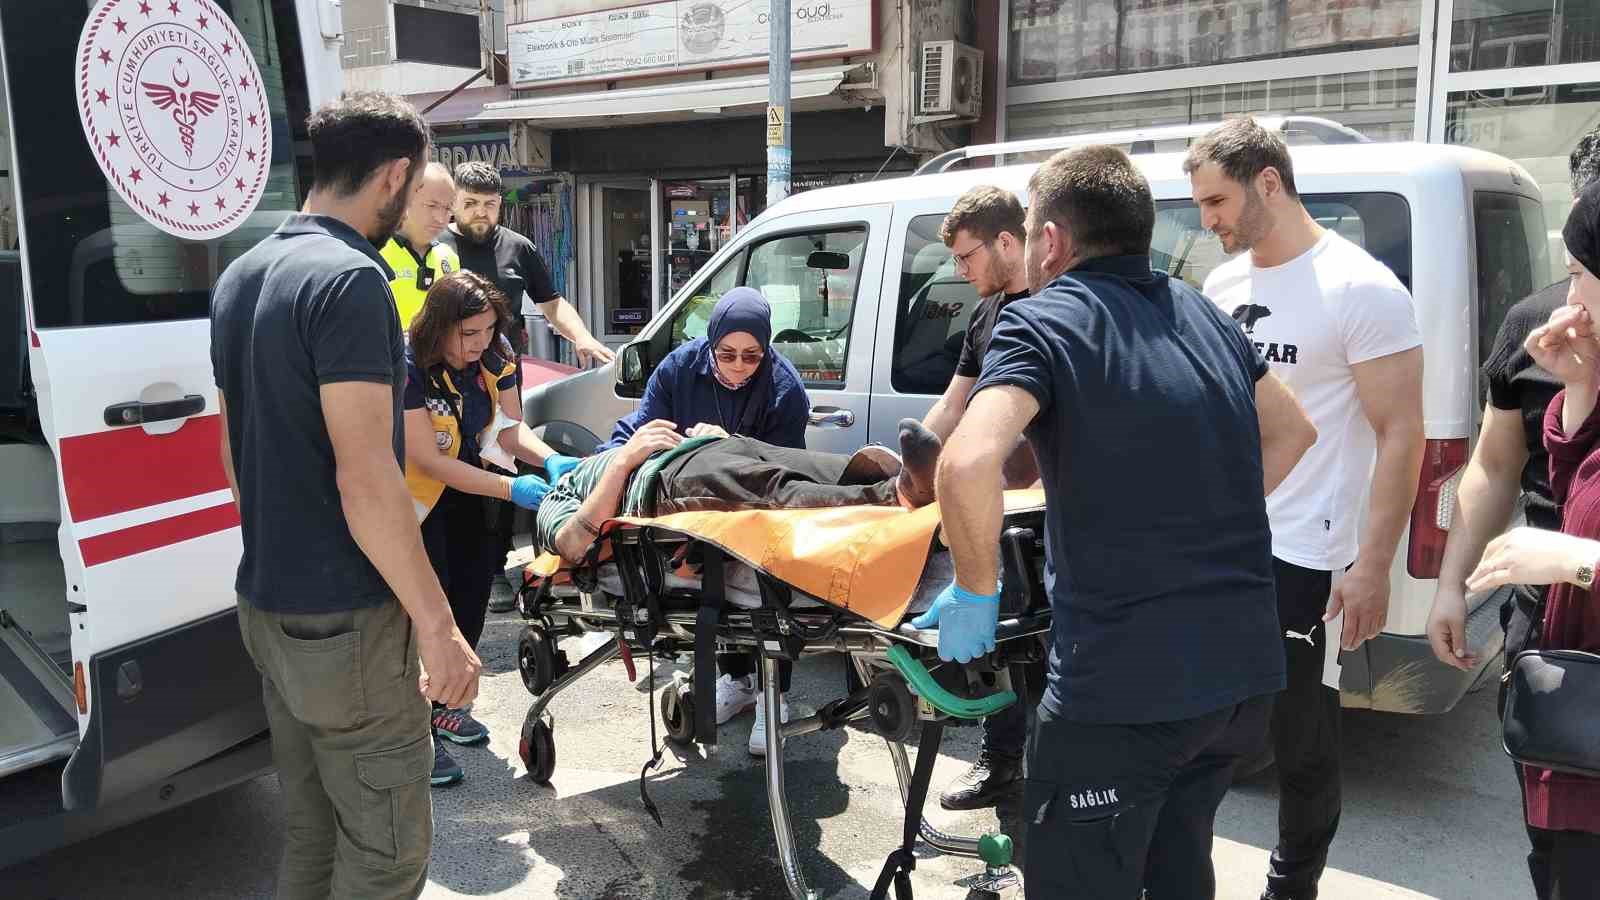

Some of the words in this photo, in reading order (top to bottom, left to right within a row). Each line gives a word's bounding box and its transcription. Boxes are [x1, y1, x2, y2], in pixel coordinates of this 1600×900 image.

[123, 30, 188, 95] CUMHURİYETİ
[215, 95, 239, 177] BAKANLIĞI
[1070, 788, 1119, 809] SAĞLIK
